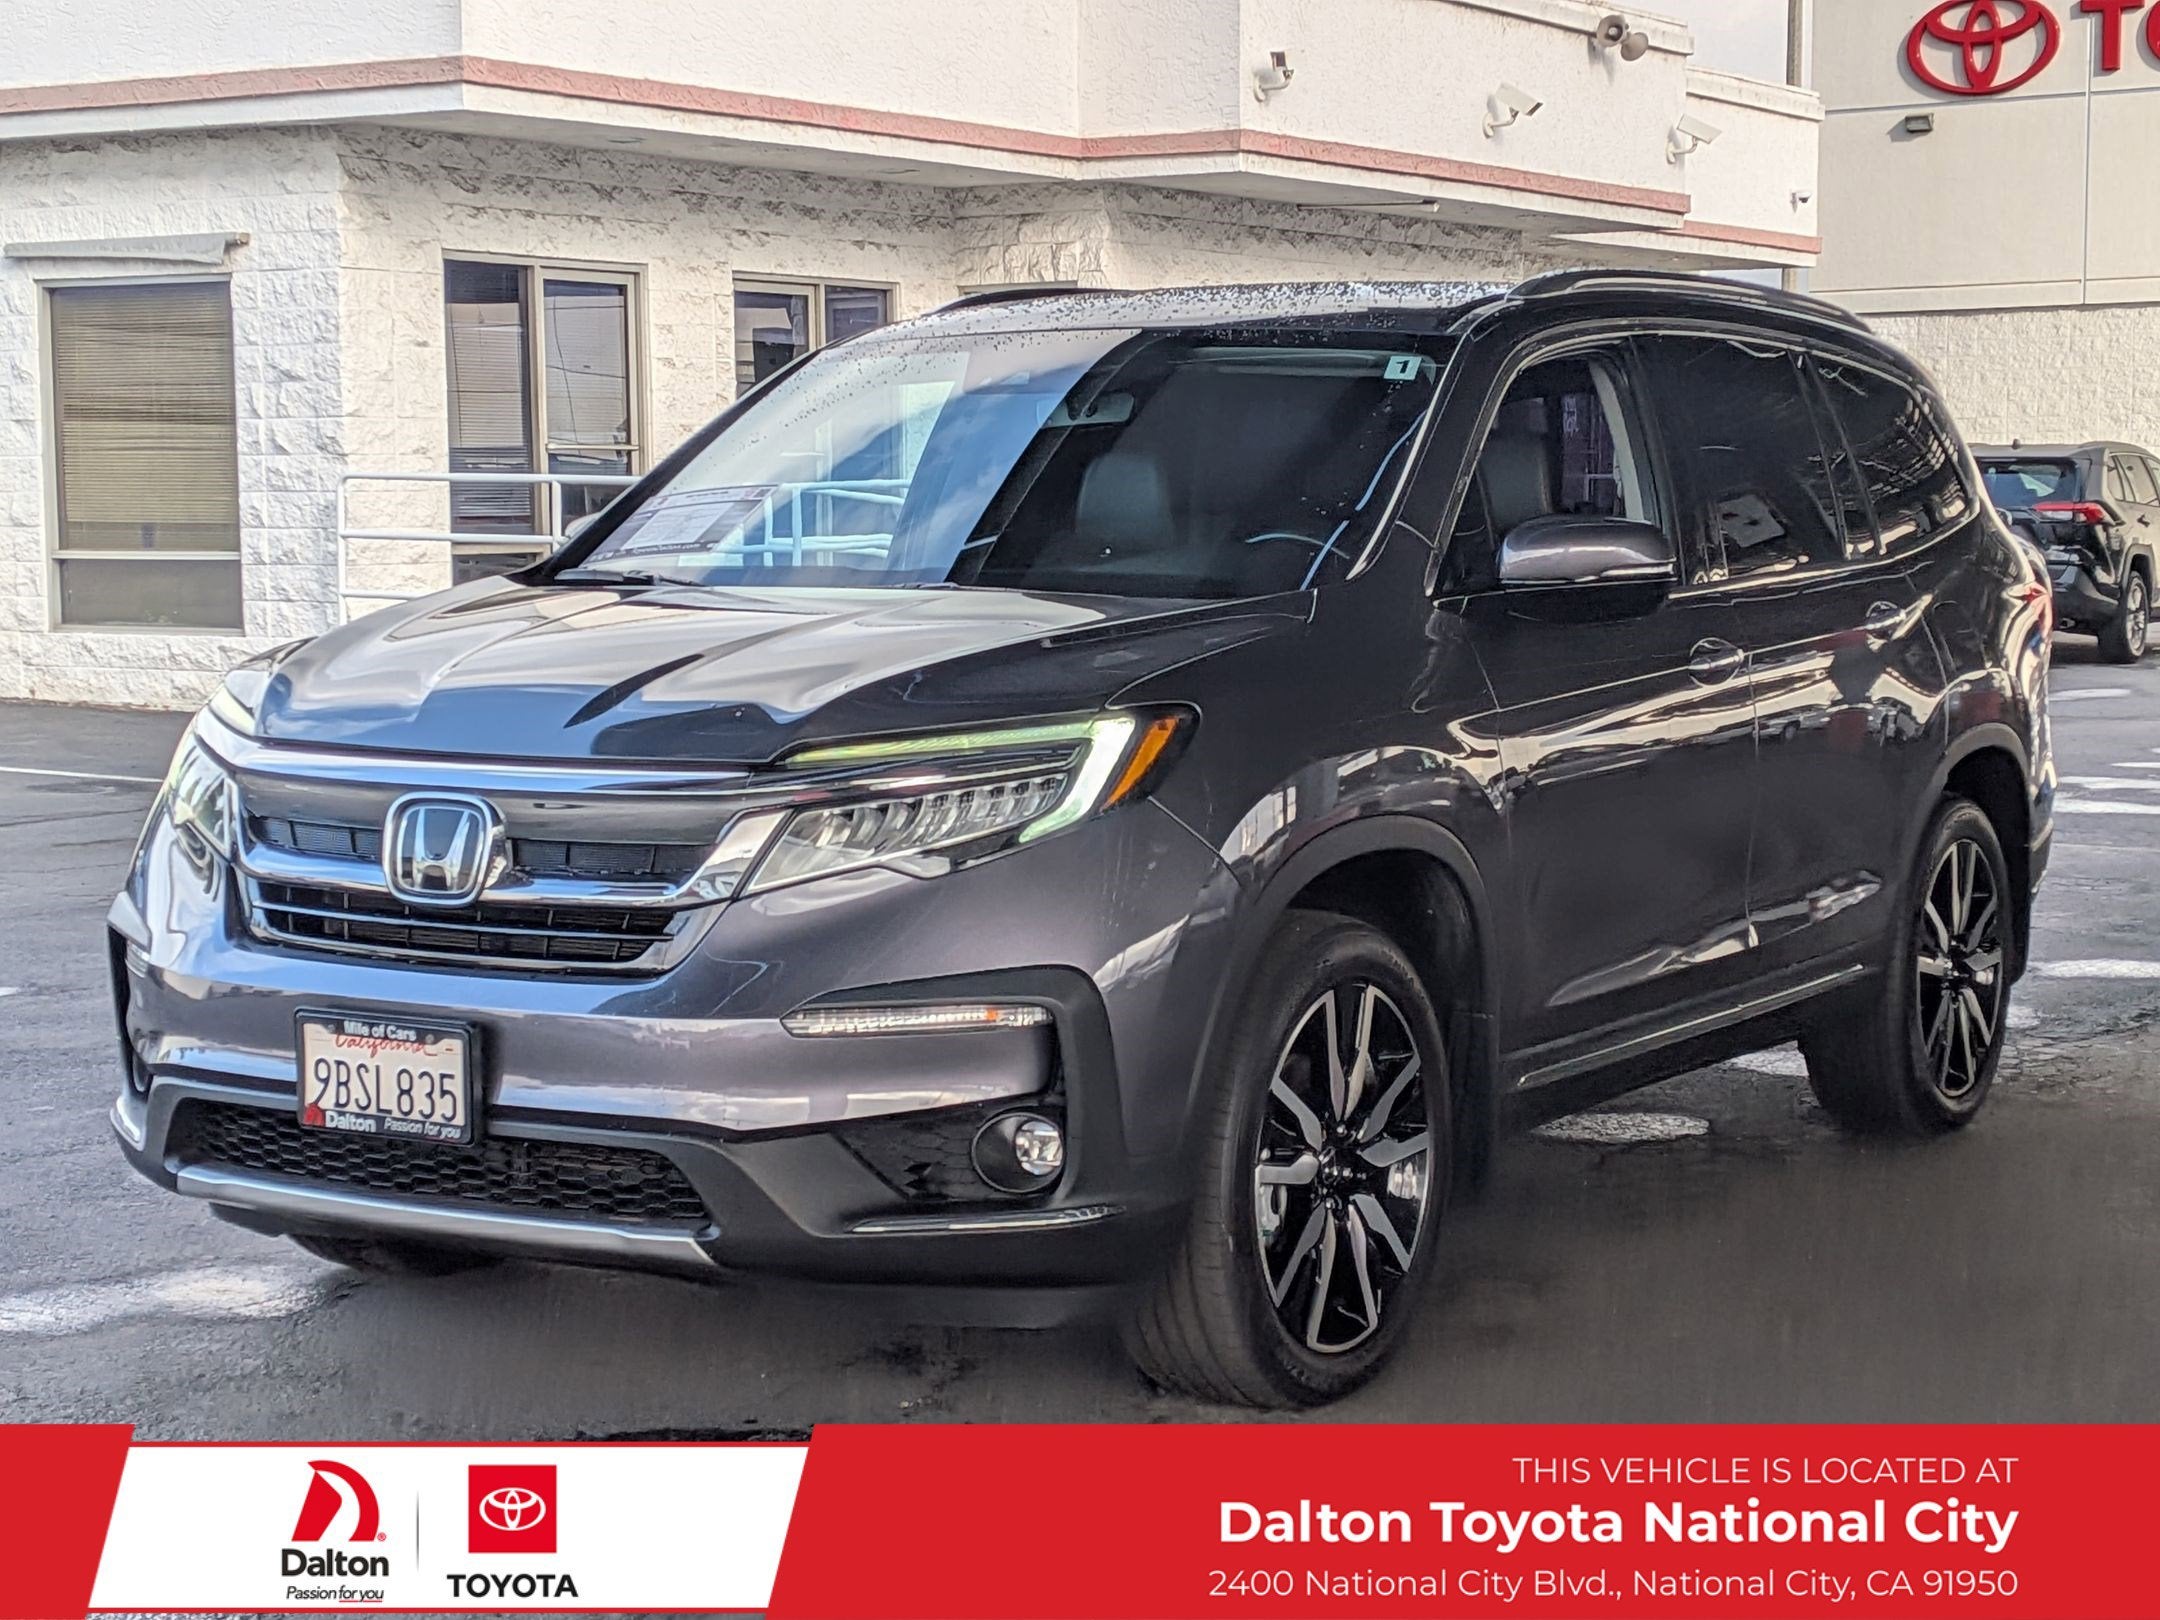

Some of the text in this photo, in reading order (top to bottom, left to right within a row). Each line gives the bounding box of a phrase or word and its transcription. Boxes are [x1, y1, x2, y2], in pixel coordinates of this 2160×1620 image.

[2080, 0, 2160, 71] T
[343, 1020, 417, 1041] Mile of Cars
[314, 1057, 457, 1122] 9BSL835
[325, 1111, 462, 1140] Dalton Passion for you
